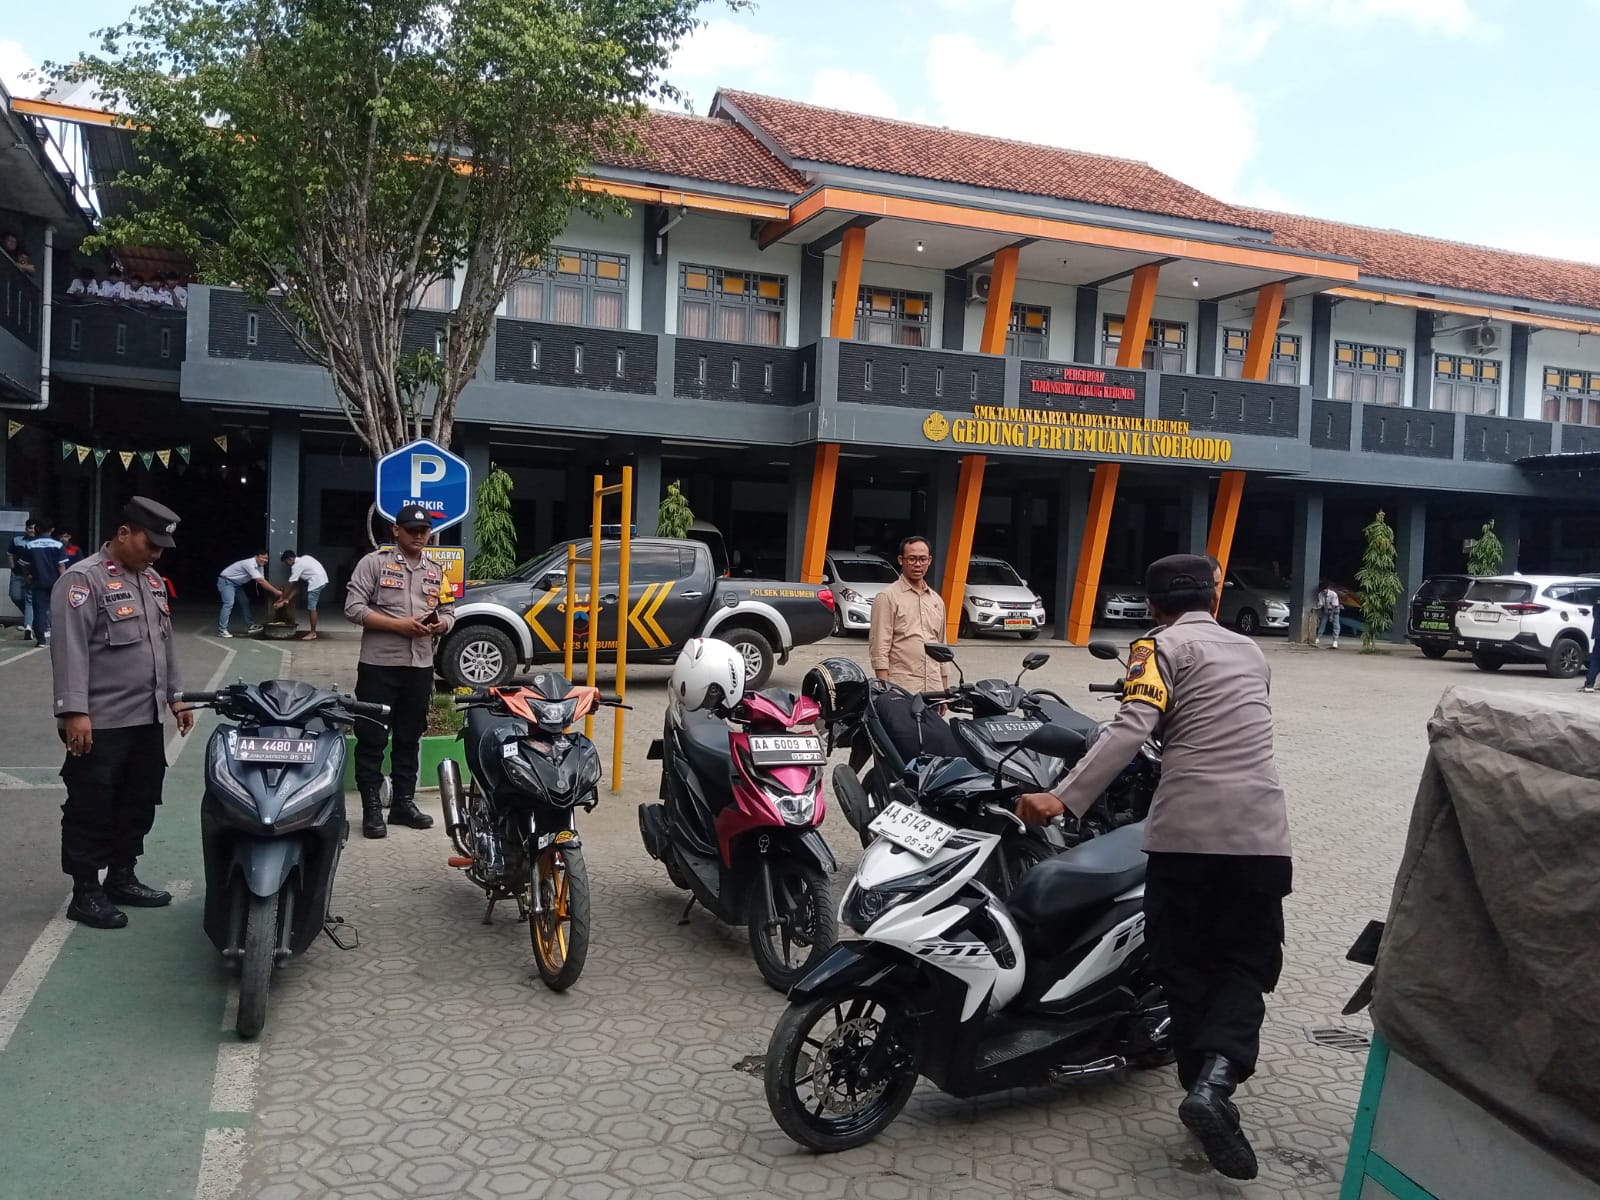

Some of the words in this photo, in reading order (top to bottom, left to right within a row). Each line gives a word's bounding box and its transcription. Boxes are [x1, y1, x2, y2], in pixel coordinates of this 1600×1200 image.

[1064, 368, 1105, 383] PERGURUAN
[1032, 380, 1075, 396] TAMANSISWA
[1076, 384, 1102, 397] CABANG
[1103, 386, 1135, 400] KEBUMEN
[974, 405, 996, 420] SMK
[997, 407, 1033, 423] TAMAN
[1034, 410, 1067, 425] KARYA
[1070, 412, 1102, 429] MADYA
[1105, 415, 1142, 431] TEKNIK
[1144, 418, 1189, 435] KEBUMEN
[952, 419, 1024, 447] GEDUNG
[1027, 424, 1129, 454] PERTEMUAN
[1151, 434, 1232, 464] SOERODJO
[411, 453, 446, 498] P
[435, 551, 462, 560] KARYA
[750, 588, 778, 597] POLSEK
[780, 589, 814, 598] KEBUMEN
[990, 723, 1003, 731] AA
[240, 740, 255, 750] AA
[262, 741, 291, 752] 4480
[297, 743, 313, 753] AM
[754, 739, 769, 750] AA
[774, 739, 800, 749] 6009
[883, 805, 902, 821] AA
[901, 812, 929, 833] 6148
[930, 830, 951, 843] RJ
